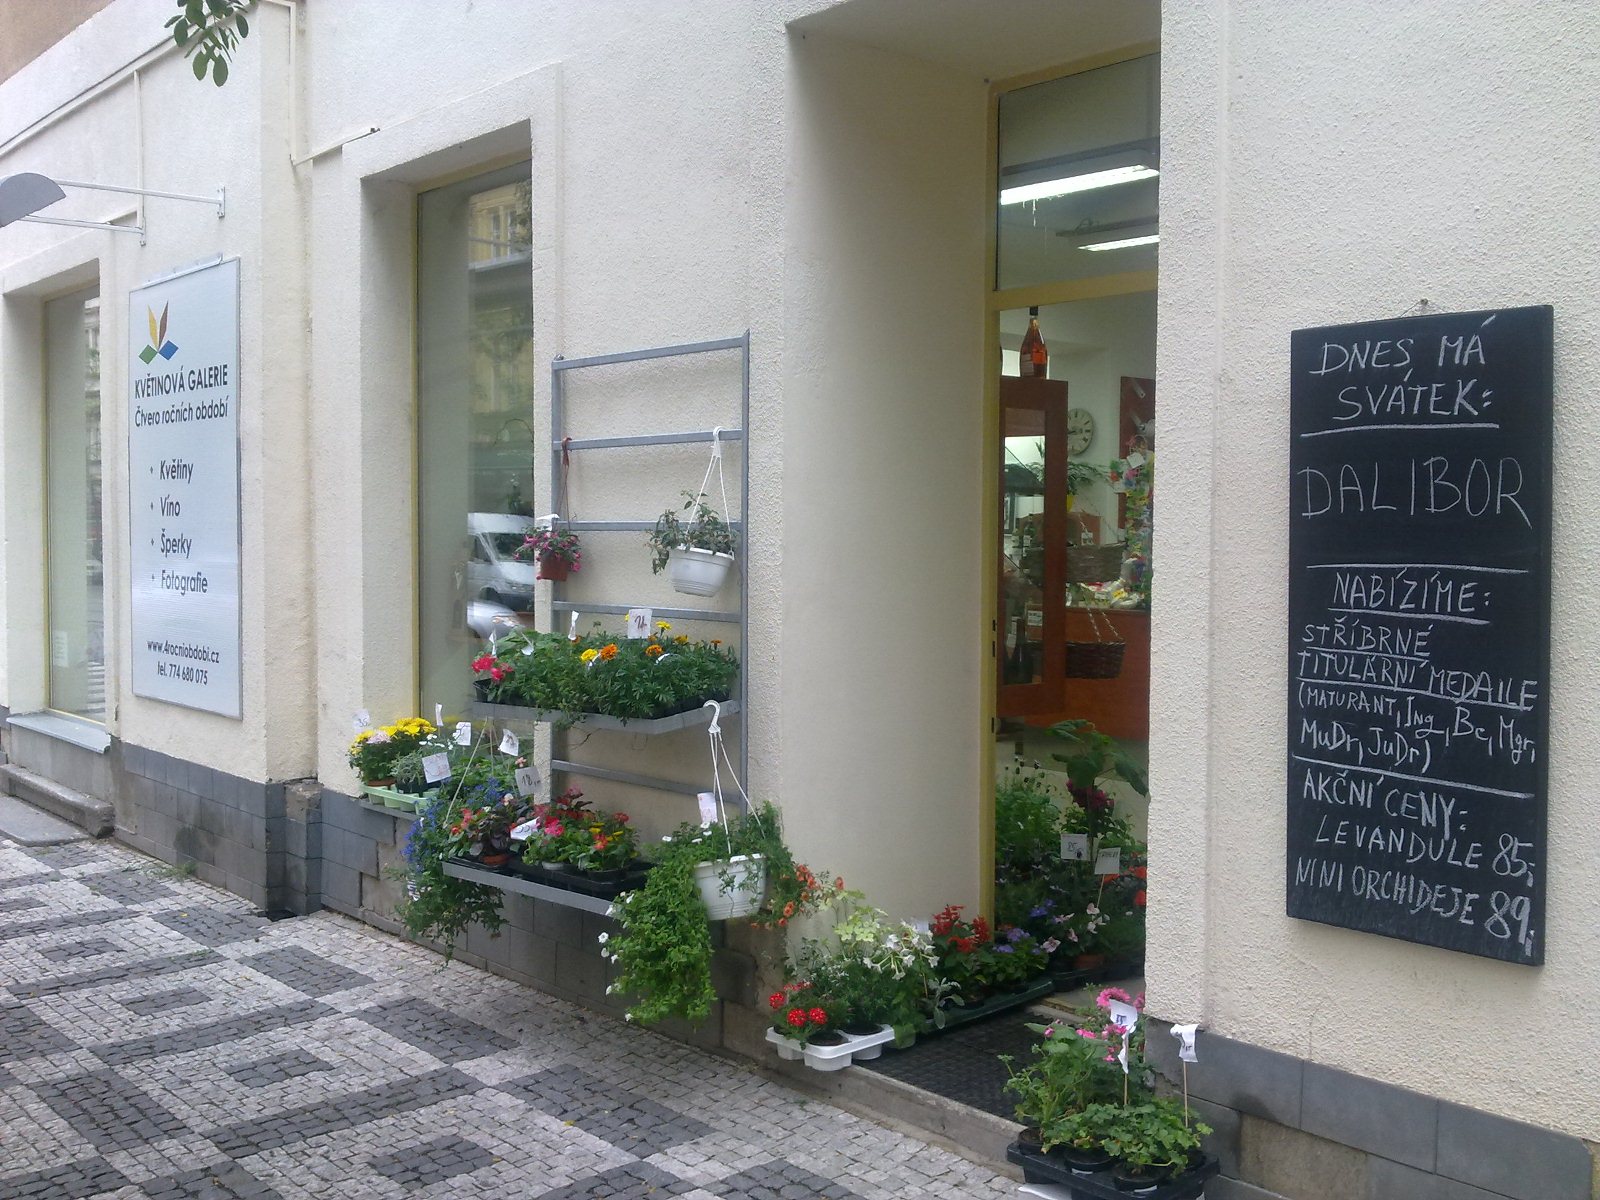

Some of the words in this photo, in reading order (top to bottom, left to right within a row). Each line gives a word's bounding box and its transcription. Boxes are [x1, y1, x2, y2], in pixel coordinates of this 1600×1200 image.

[1309, 338, 1413, 376] DNES
[1438, 313, 1496, 366] MÁ
[134, 365, 185, 399] KVĚTINOVÁ
[188, 364, 228, 391] GALERIE
[1332, 368, 1493, 420] SVÁTEK:
[134, 406, 160, 427] Čtvero
[162, 402, 193, 424] ročních
[195, 395, 229, 420] období
[160, 458, 194, 484] Květiny
[160, 494, 181, 517] Víno
[1297, 456, 1532, 529] DALIBOR
[160, 528, 192, 559] Šperky
[161, 569, 208, 596] Fotografie
[1333, 567, 1491, 613] NABÍZÍME:
[146, 640, 220, 664] www.4rocniobdobi.cz
[1302, 616, 1434, 656] STŘÍBRNÉ
[169, 663, 180, 679] 774
[182, 665, 194, 682] 680
[195, 669, 208, 685] 075
[1297, 651, 1429, 691] TITULÁRNÍ
[1428, 666, 1538, 711] MEDAILE
[1303, 768, 1384, 808] AKČNÍ
[1384, 788, 1468, 841] CENY:
[1316, 815, 1482, 869] LEVANDULE
[1352, 866, 1480, 926] ORCHIDEJE
